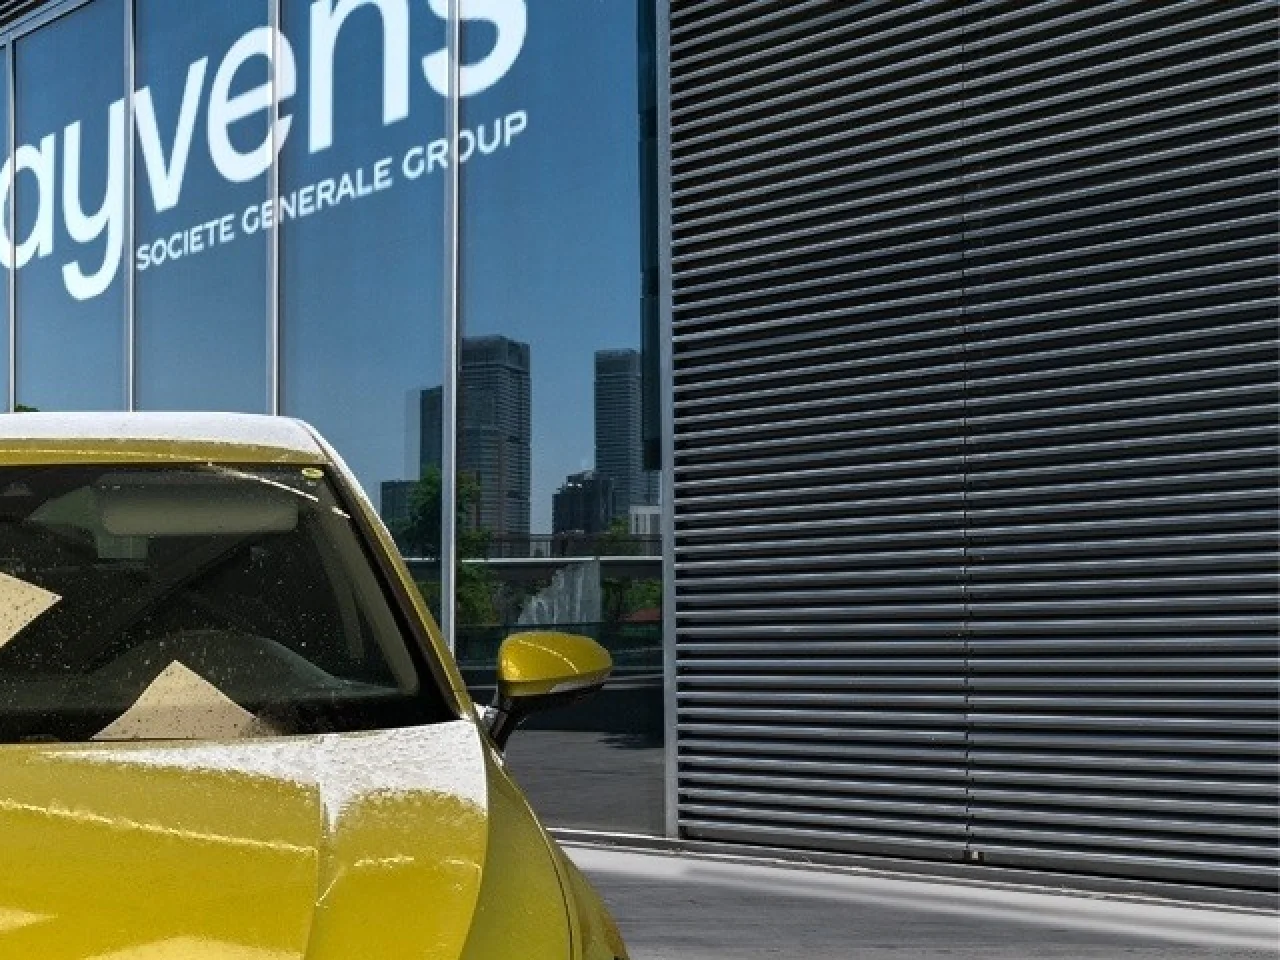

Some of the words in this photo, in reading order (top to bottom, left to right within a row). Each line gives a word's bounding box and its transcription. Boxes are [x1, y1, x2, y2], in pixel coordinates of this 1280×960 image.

[135, 213, 236, 271] SOCIETE
[241, 157, 394, 235] GENERALE
[402, 109, 528, 180] GROUP
